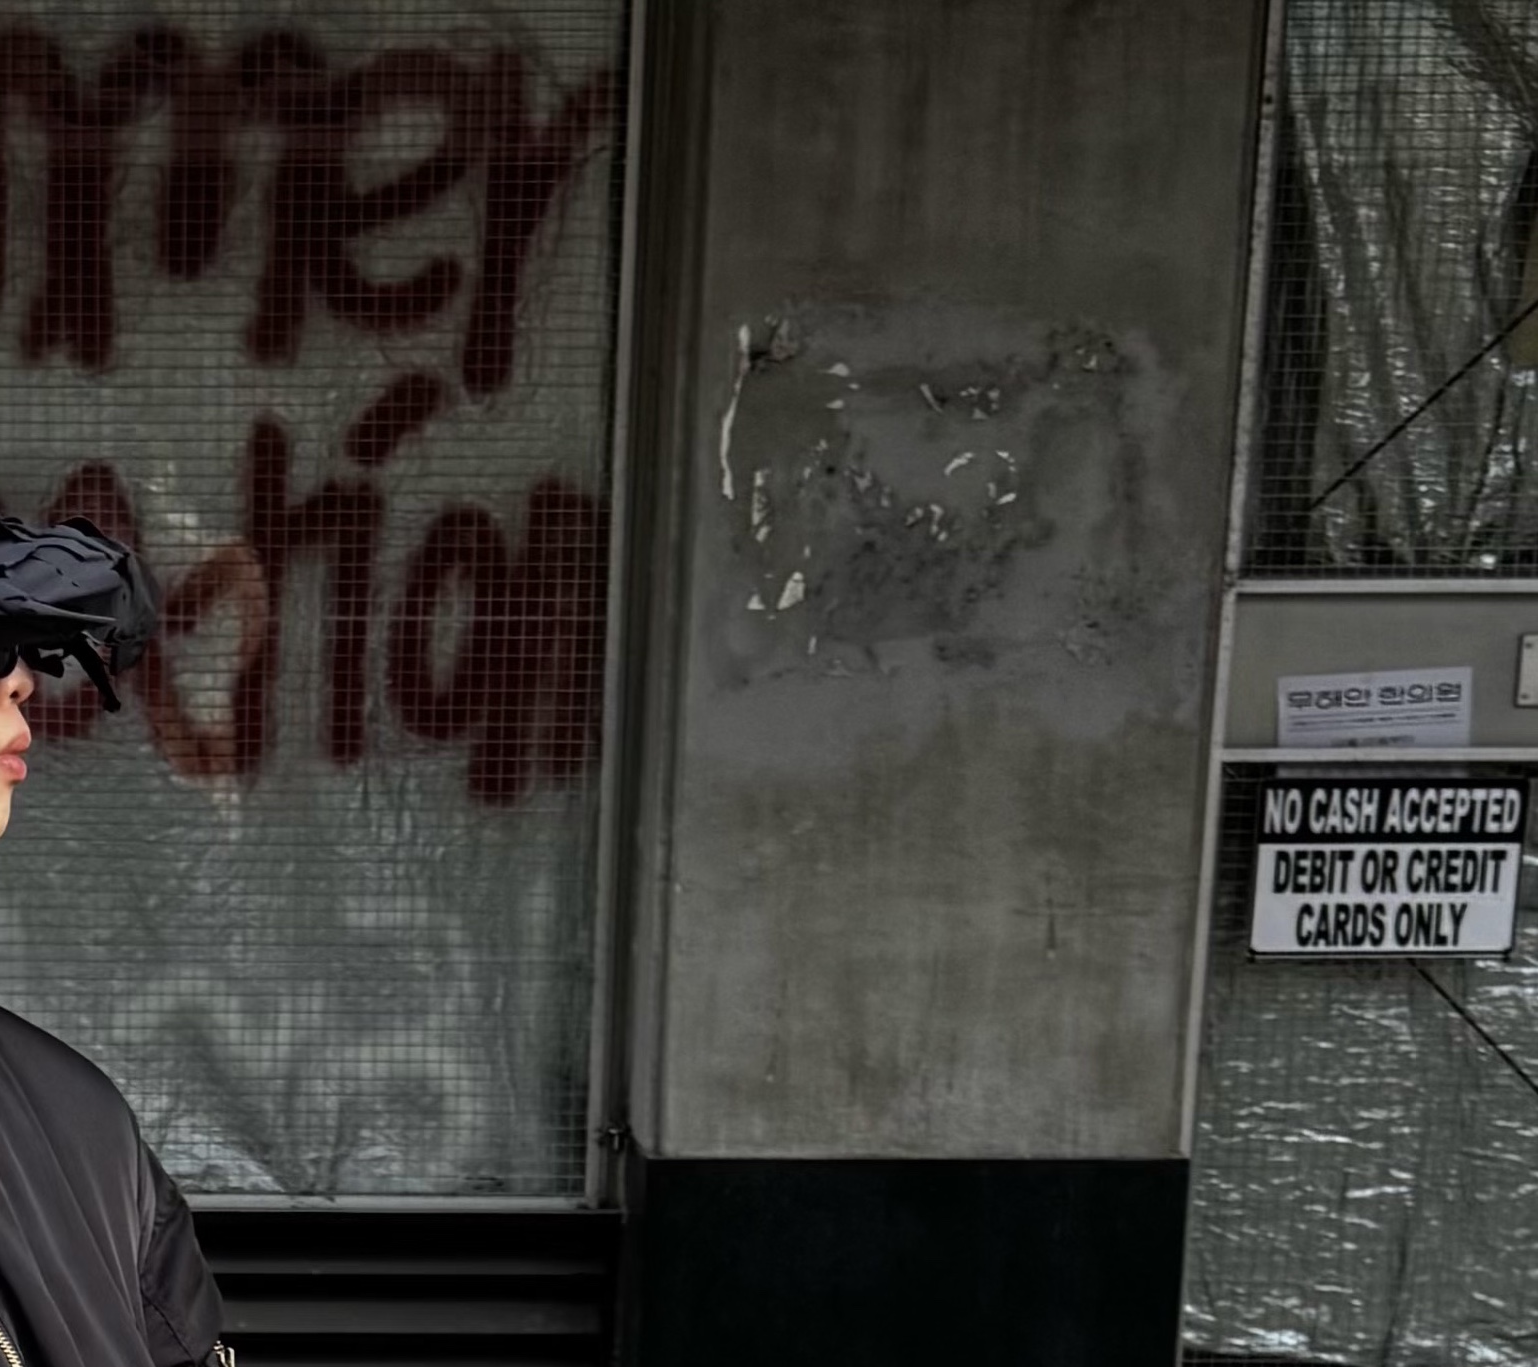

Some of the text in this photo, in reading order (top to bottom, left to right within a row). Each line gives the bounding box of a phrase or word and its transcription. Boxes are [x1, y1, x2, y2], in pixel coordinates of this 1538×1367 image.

[1263, 788, 1522, 834] NO CASH ACCEPTED
[1272, 850, 1508, 894] DEBIT OR CREDIT
[1295, 903, 1468, 948] CARDS ONLY
